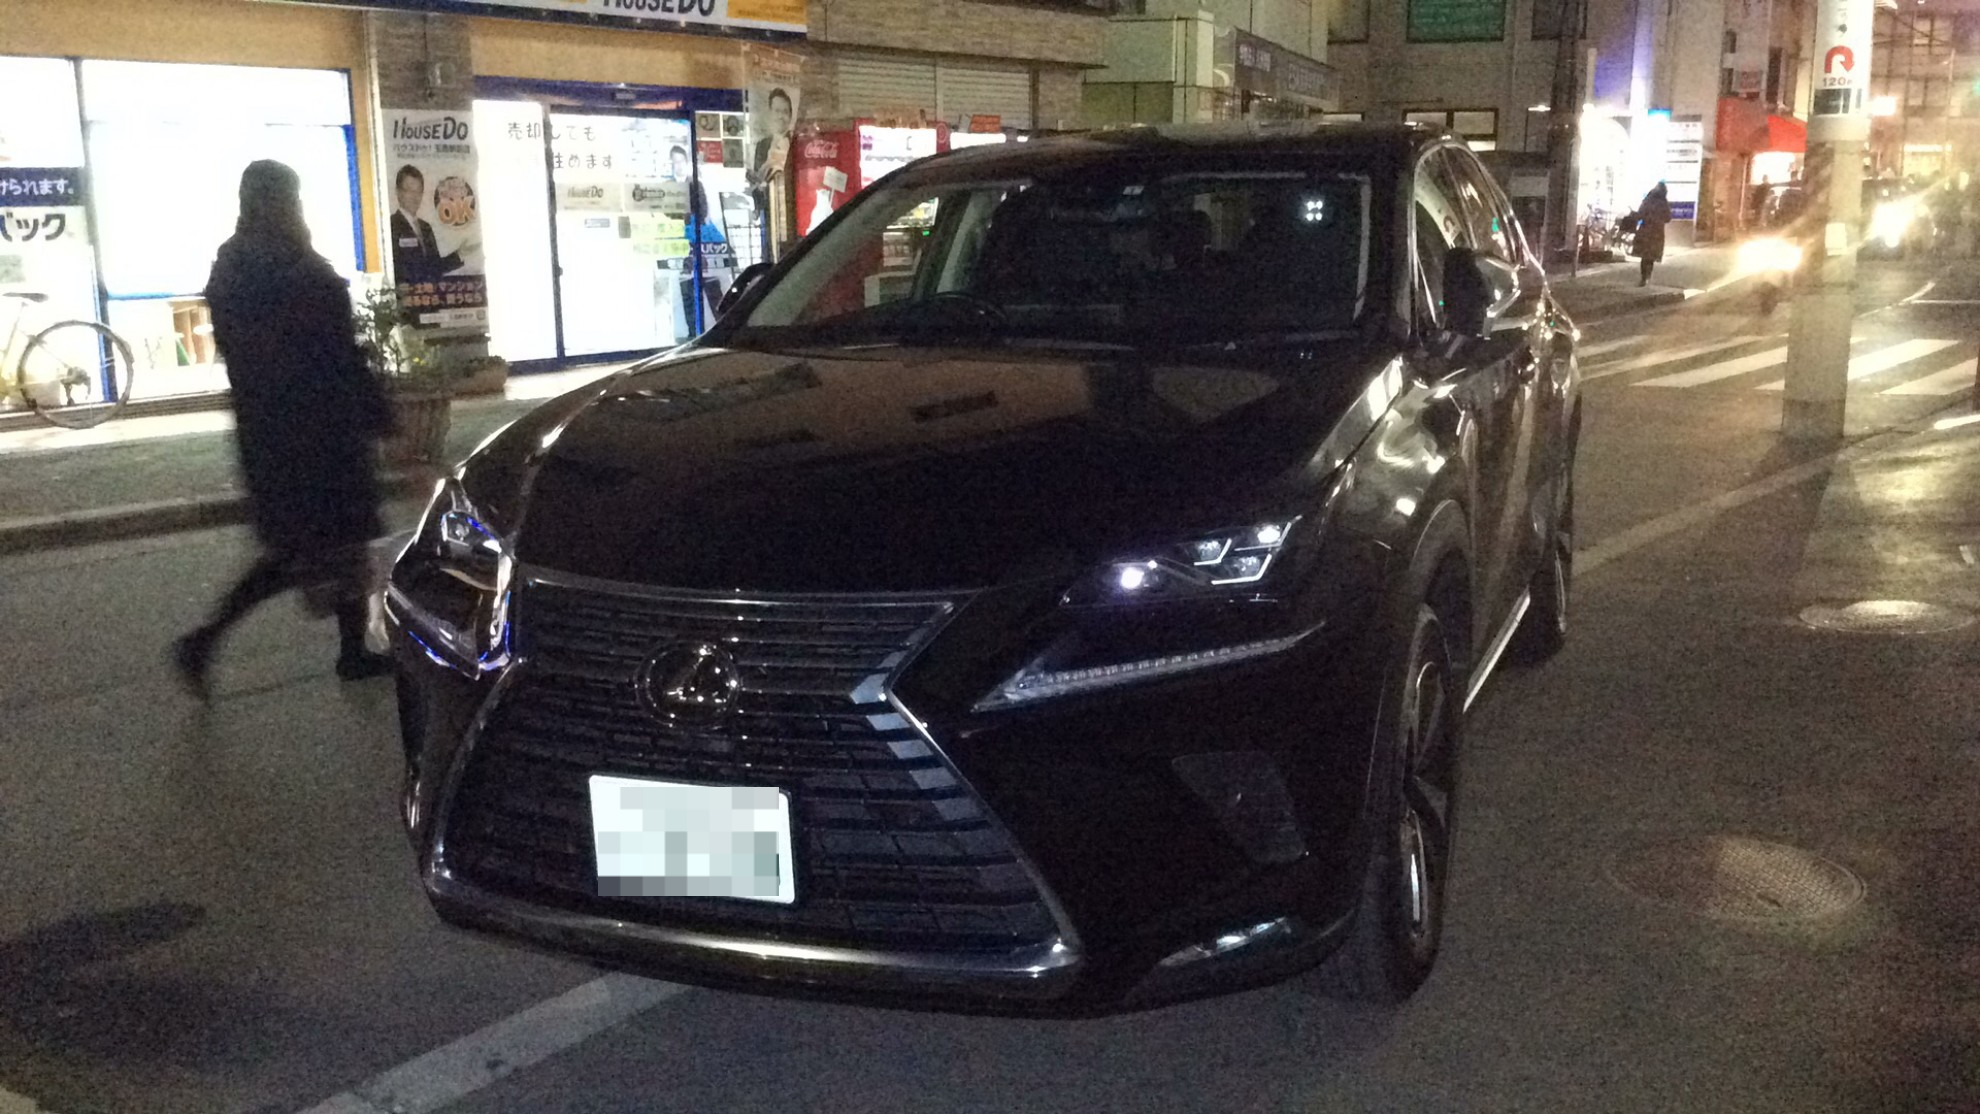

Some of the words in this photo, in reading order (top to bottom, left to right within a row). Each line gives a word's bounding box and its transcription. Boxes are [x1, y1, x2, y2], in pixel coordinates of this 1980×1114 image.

[603, 0, 715, 16] OUSEO
[508, 122, 596, 141] 売却しても
